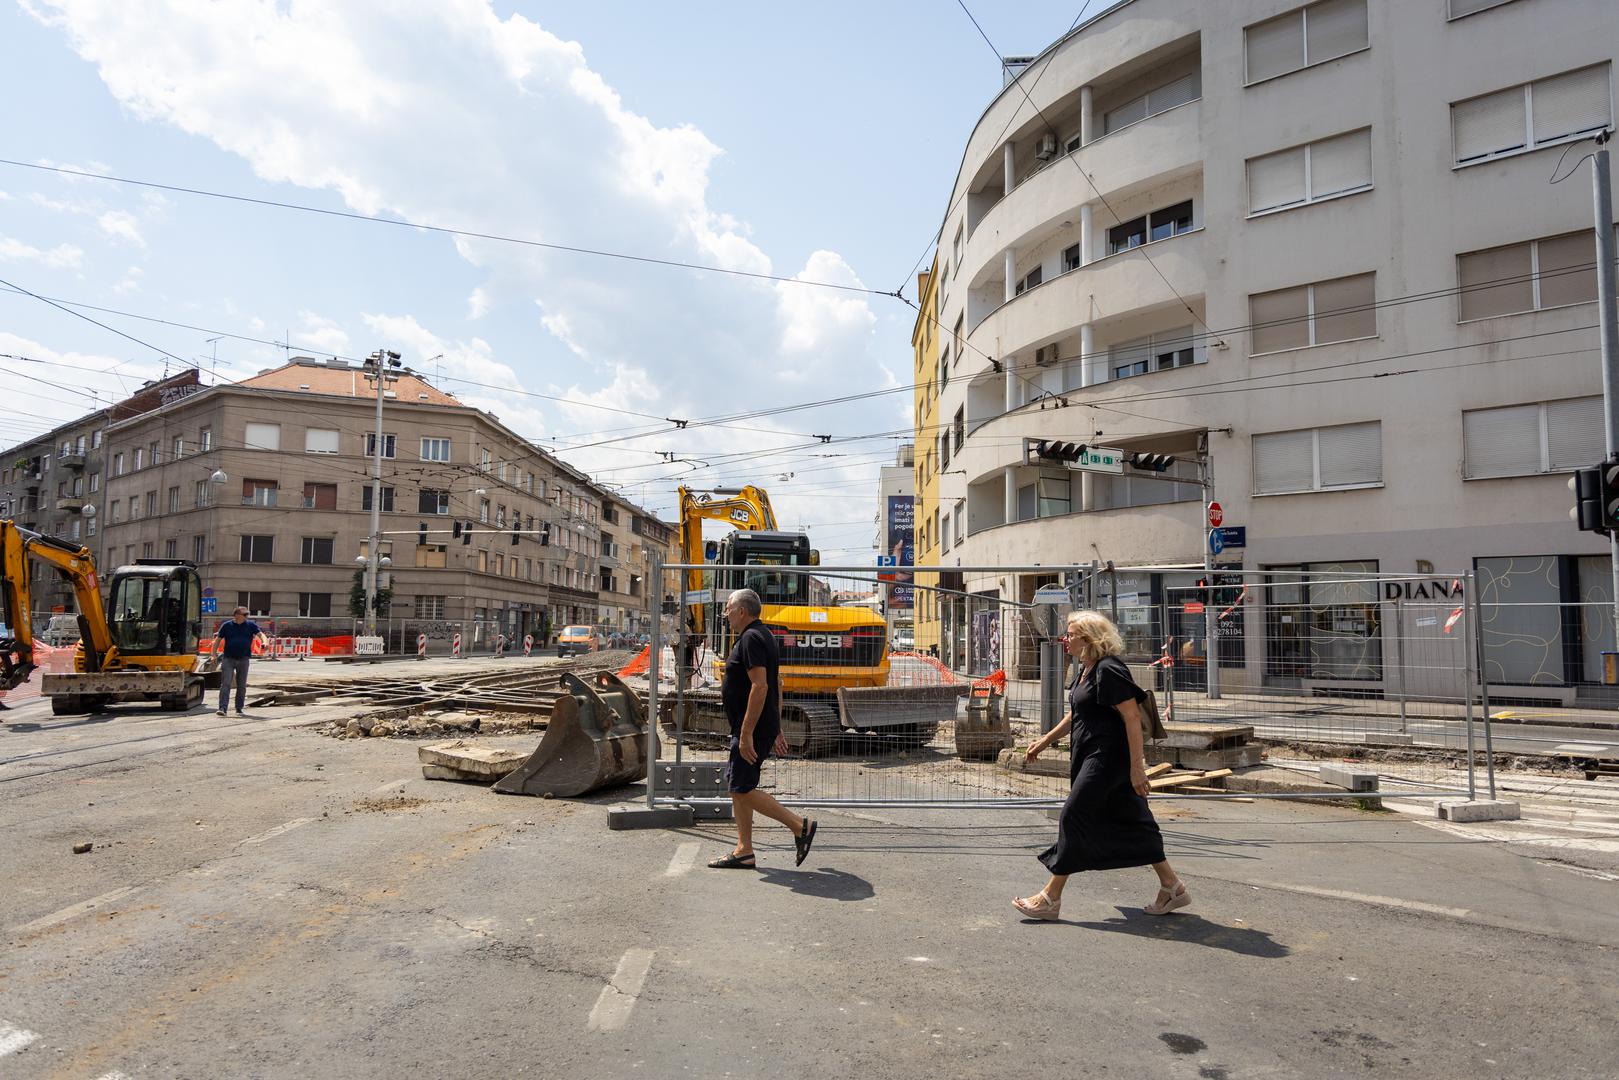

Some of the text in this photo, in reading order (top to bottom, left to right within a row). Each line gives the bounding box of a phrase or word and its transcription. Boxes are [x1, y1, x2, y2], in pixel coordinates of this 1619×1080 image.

[730, 508, 749, 522] JCB
[1209, 509, 1222, 520] STOP
[1385, 581, 1464, 600] DIANA
[797, 634, 842, 648] JCB
